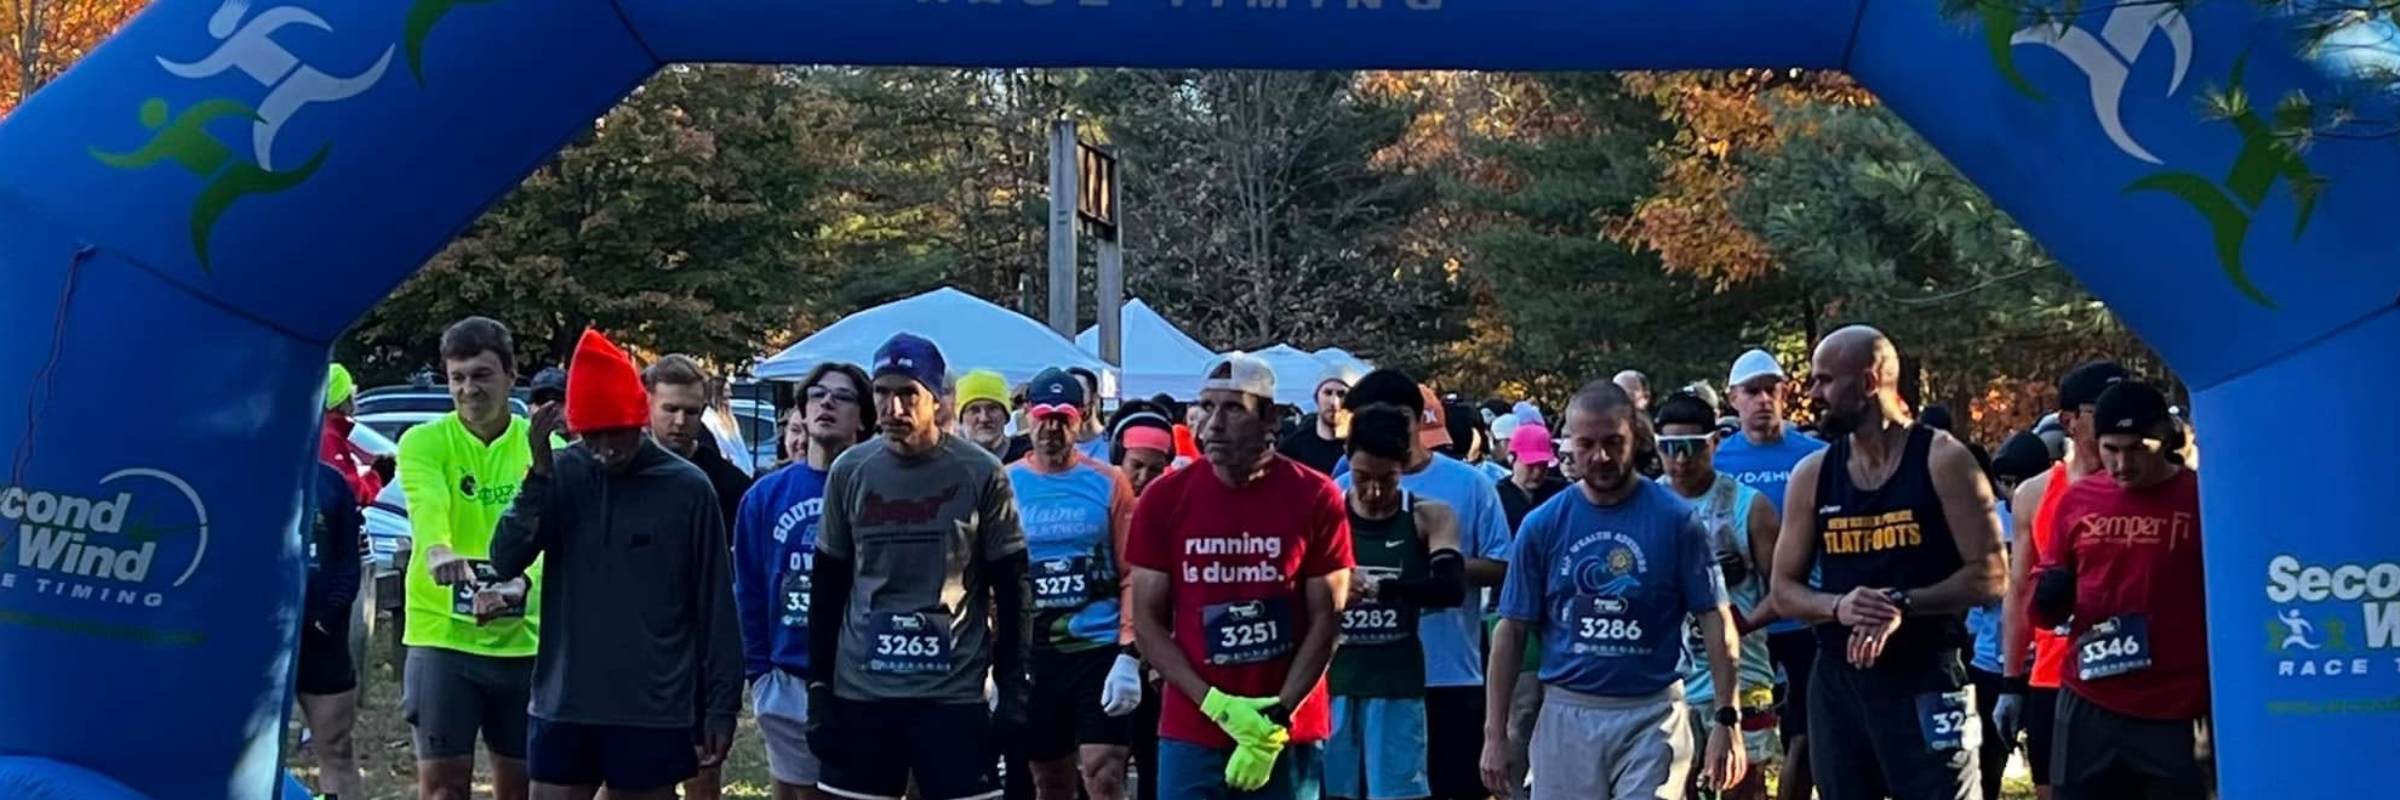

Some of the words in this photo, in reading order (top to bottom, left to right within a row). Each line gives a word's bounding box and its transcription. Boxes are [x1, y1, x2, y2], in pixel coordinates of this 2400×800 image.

[0, 486, 132, 533] cond
[1185, 531, 1281, 558] running
[2080, 513, 2167, 549] Semper
[2169, 511, 2192, 553] Fi
[18, 523, 156, 583] Wind
[1035, 574, 1086, 595] 3273
[1202, 560, 1285, 583] dumb.
[2266, 554, 2400, 602] Seco
[36, 578, 162, 607] TIMING
[1340, 609, 1398, 629] 3282
[1579, 617, 1643, 641] 3286
[877, 634, 940, 657] 3263
[1220, 620, 1278, 648] 3251
[2083, 635, 2140, 664] 3346
[2278, 658, 2369, 677] RACE
